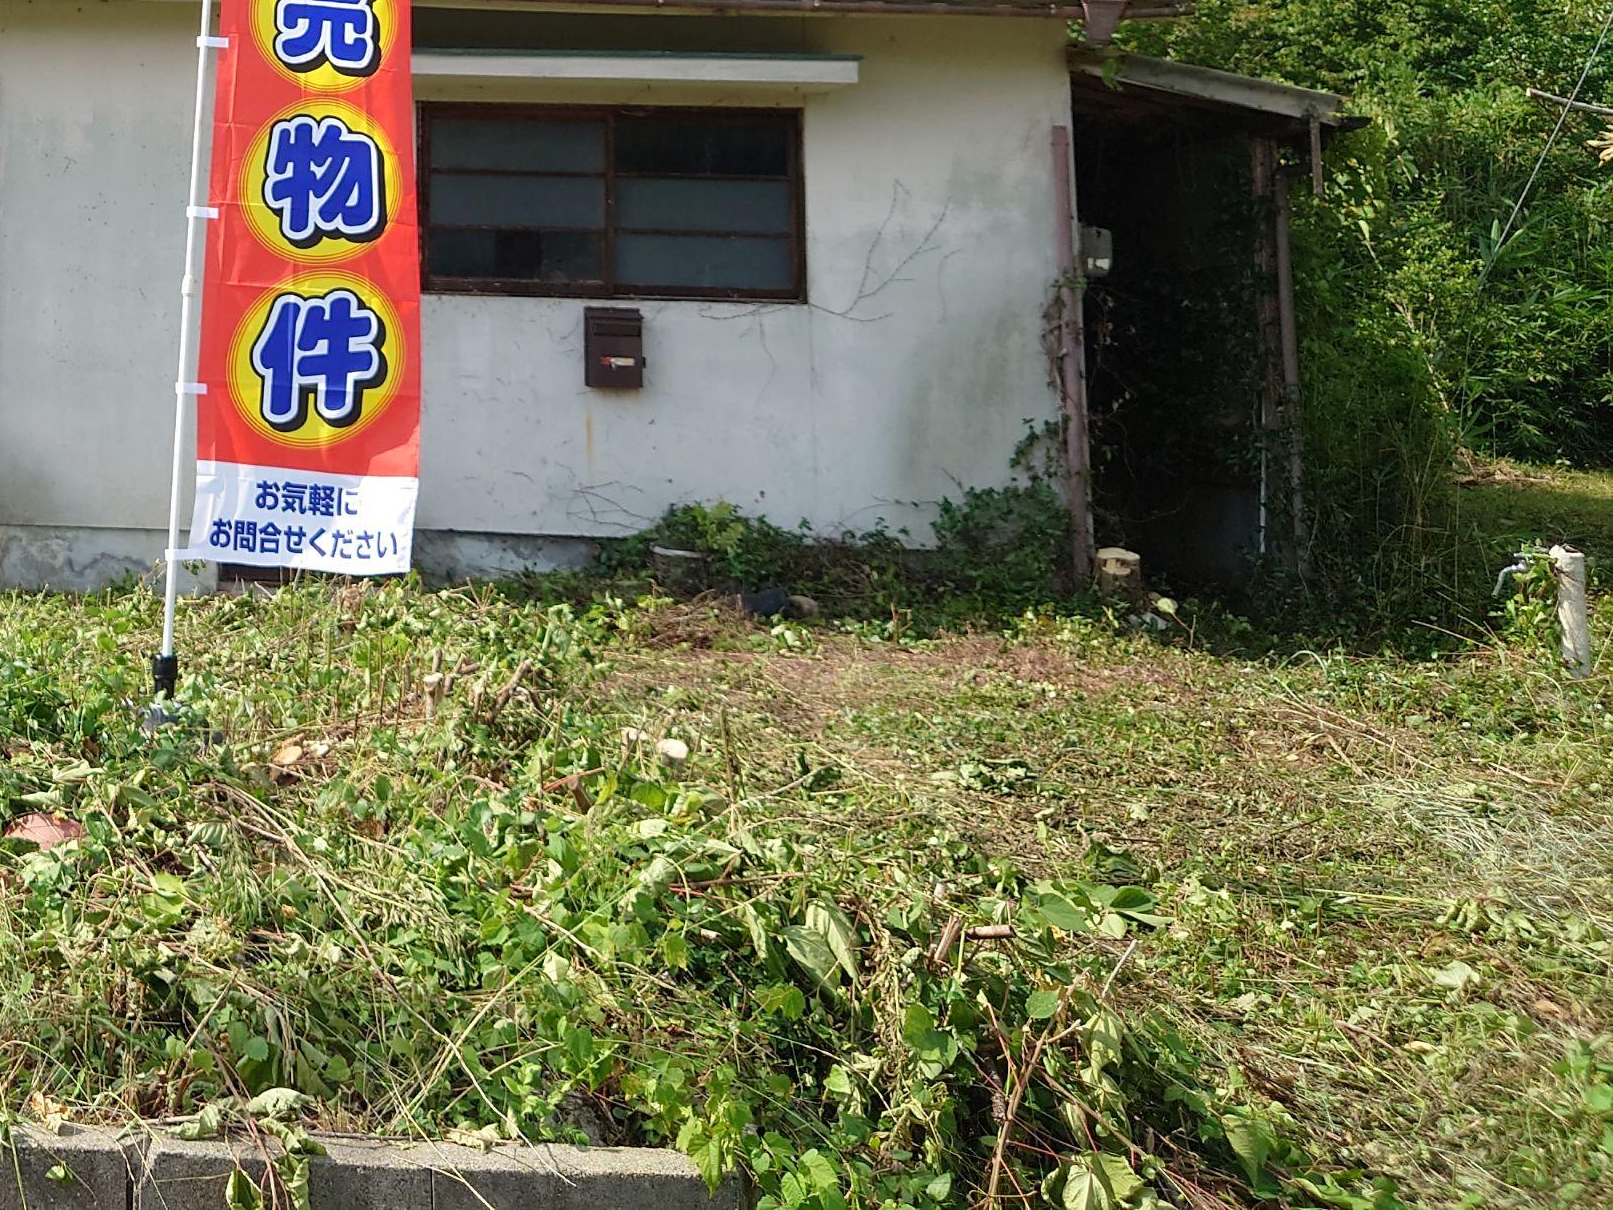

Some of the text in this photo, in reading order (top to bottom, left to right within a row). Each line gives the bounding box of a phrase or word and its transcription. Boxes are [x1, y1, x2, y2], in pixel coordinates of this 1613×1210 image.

[255, 480, 359, 517] お気軽に
[209, 517, 398, 560] お問合せください
